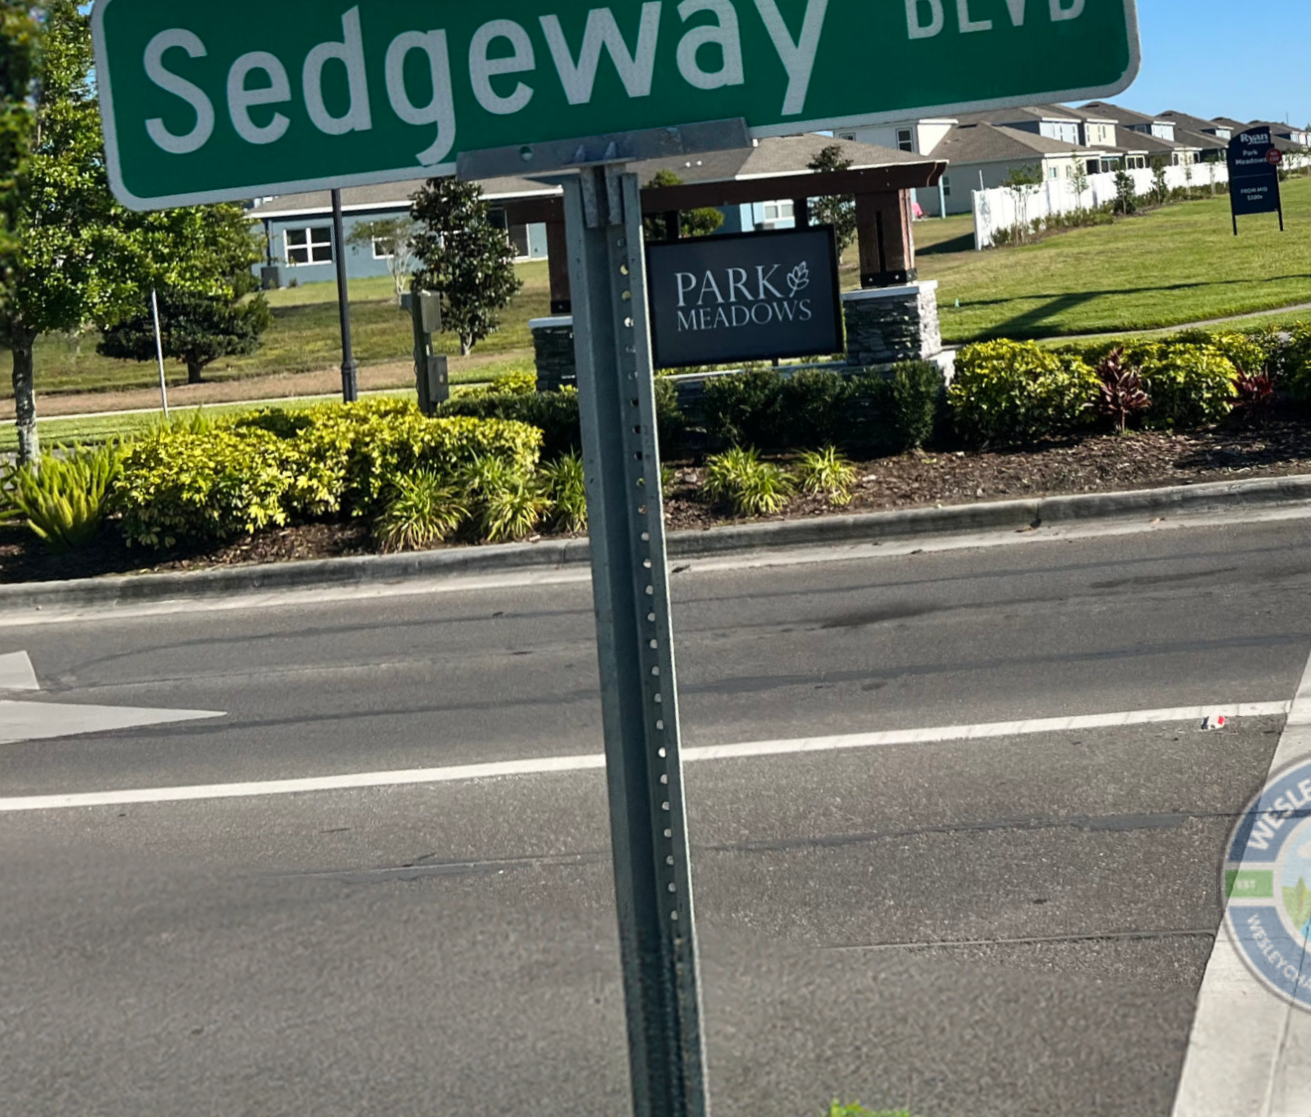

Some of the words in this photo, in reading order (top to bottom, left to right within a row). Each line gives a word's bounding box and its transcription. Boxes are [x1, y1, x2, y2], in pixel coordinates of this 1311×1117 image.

[1240, 133, 1269, 145] Ryan
[1243, 149, 1258, 157] Park
[674, 263, 785, 307] PARK
[677, 299, 812, 332] MEADOWS
